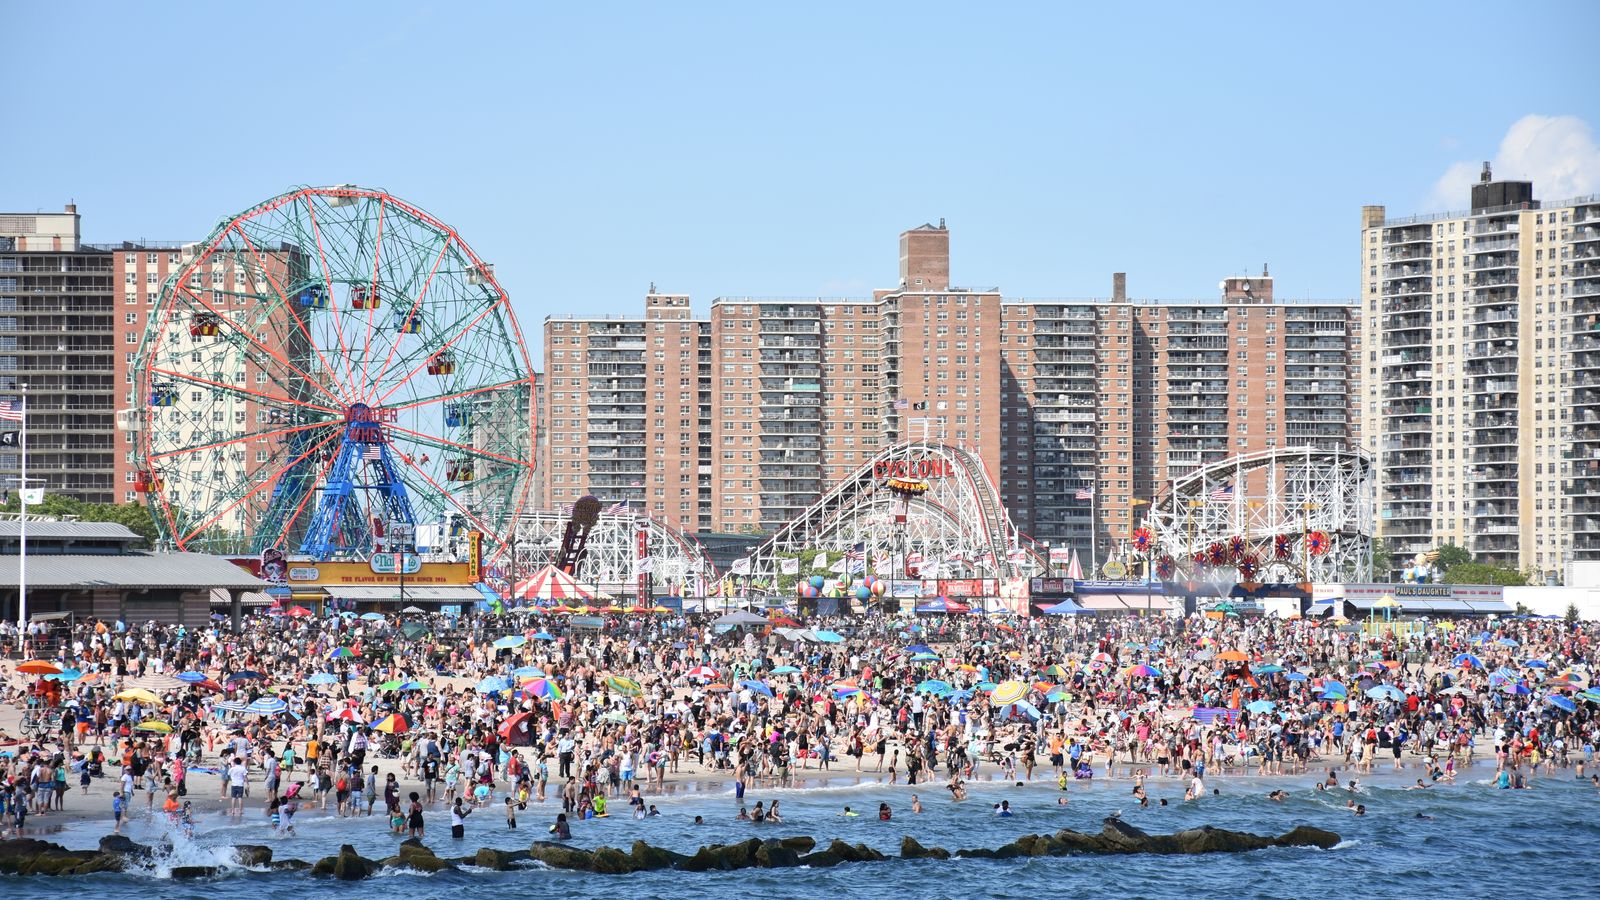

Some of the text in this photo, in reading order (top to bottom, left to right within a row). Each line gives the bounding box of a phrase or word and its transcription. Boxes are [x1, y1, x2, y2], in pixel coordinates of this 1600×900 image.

[344, 408, 398, 423] WONDER
[348, 427, 395, 443] WHEEL
[873, 459, 954, 479] CYCLONE
[374, 553, 417, 567] Na's
[1396, 587, 1416, 595] PAUL'S
[1417, 587, 1451, 596] DAUGHTER
